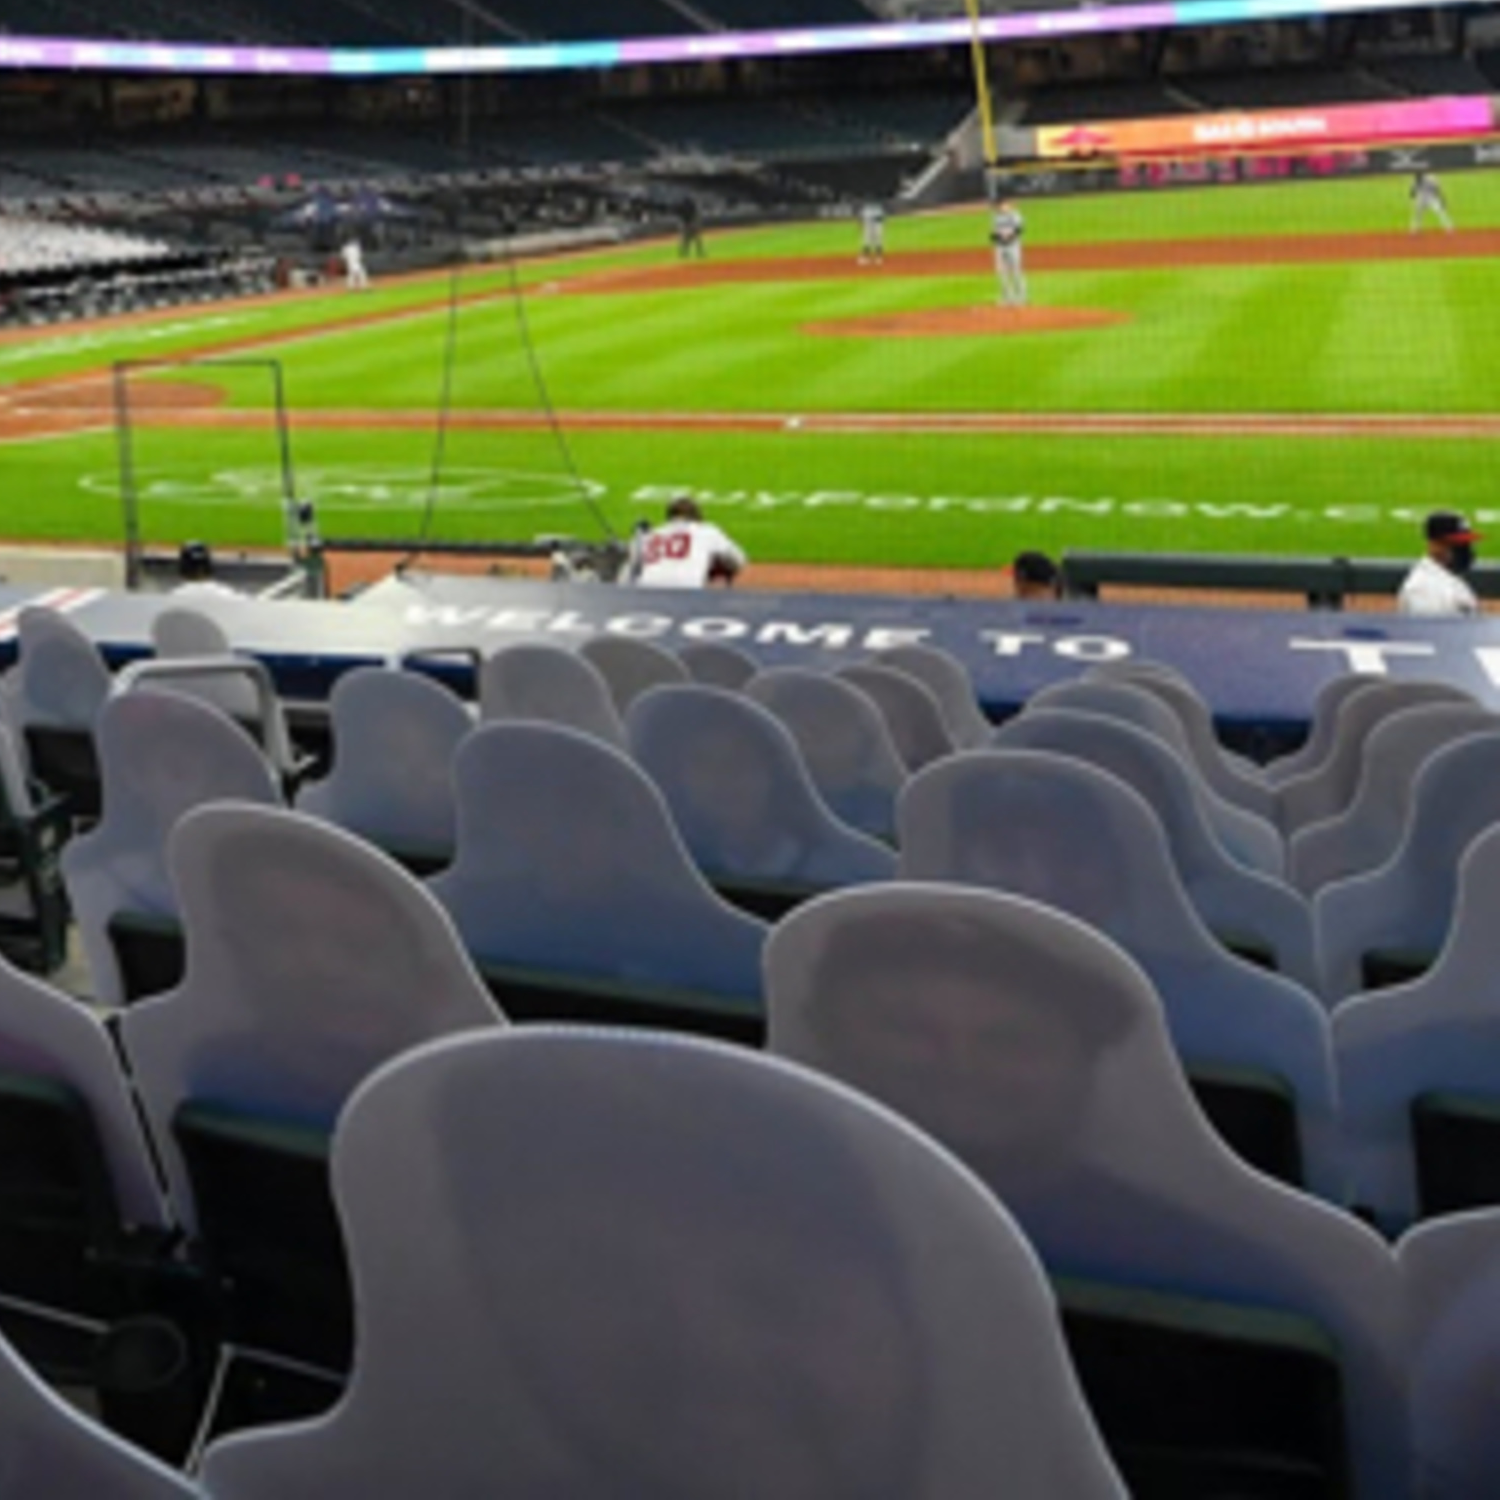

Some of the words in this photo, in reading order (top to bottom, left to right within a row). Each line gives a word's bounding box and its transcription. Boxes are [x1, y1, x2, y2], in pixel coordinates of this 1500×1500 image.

[402, 603, 932, 650] WELCOME
[980, 629, 1130, 662] TO
[1288, 637, 1500, 690] T
